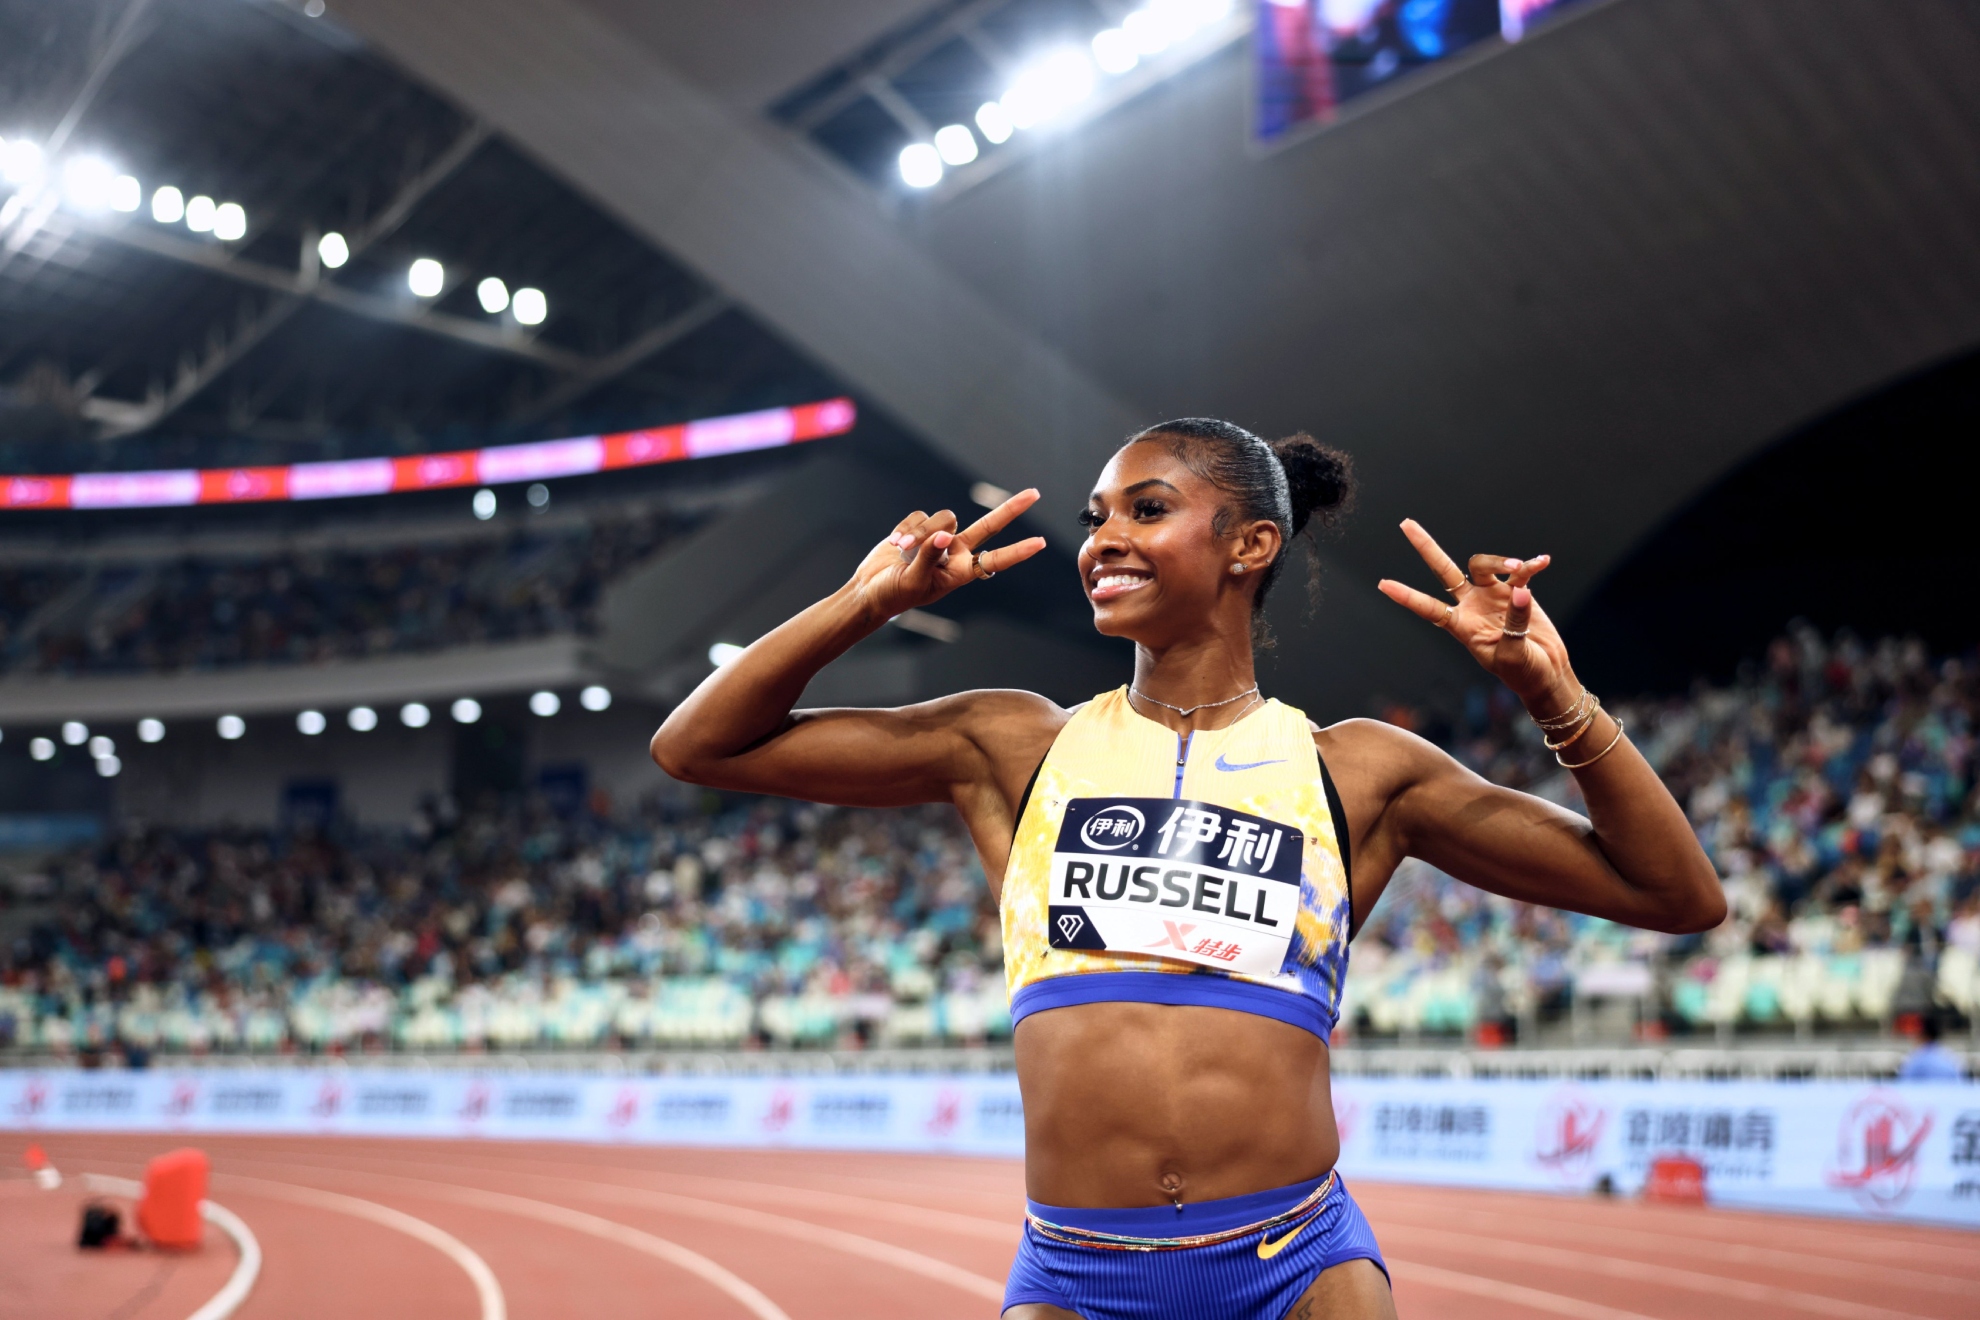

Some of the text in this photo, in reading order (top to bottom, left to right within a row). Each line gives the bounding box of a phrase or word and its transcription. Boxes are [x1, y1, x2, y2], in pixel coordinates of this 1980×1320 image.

[1089, 817, 1137, 838] 伊利
[1158, 806, 1283, 874] 伊利
[1063, 861, 1278, 928] RUSSELL
[1189, 938, 1243, 962] 特步
